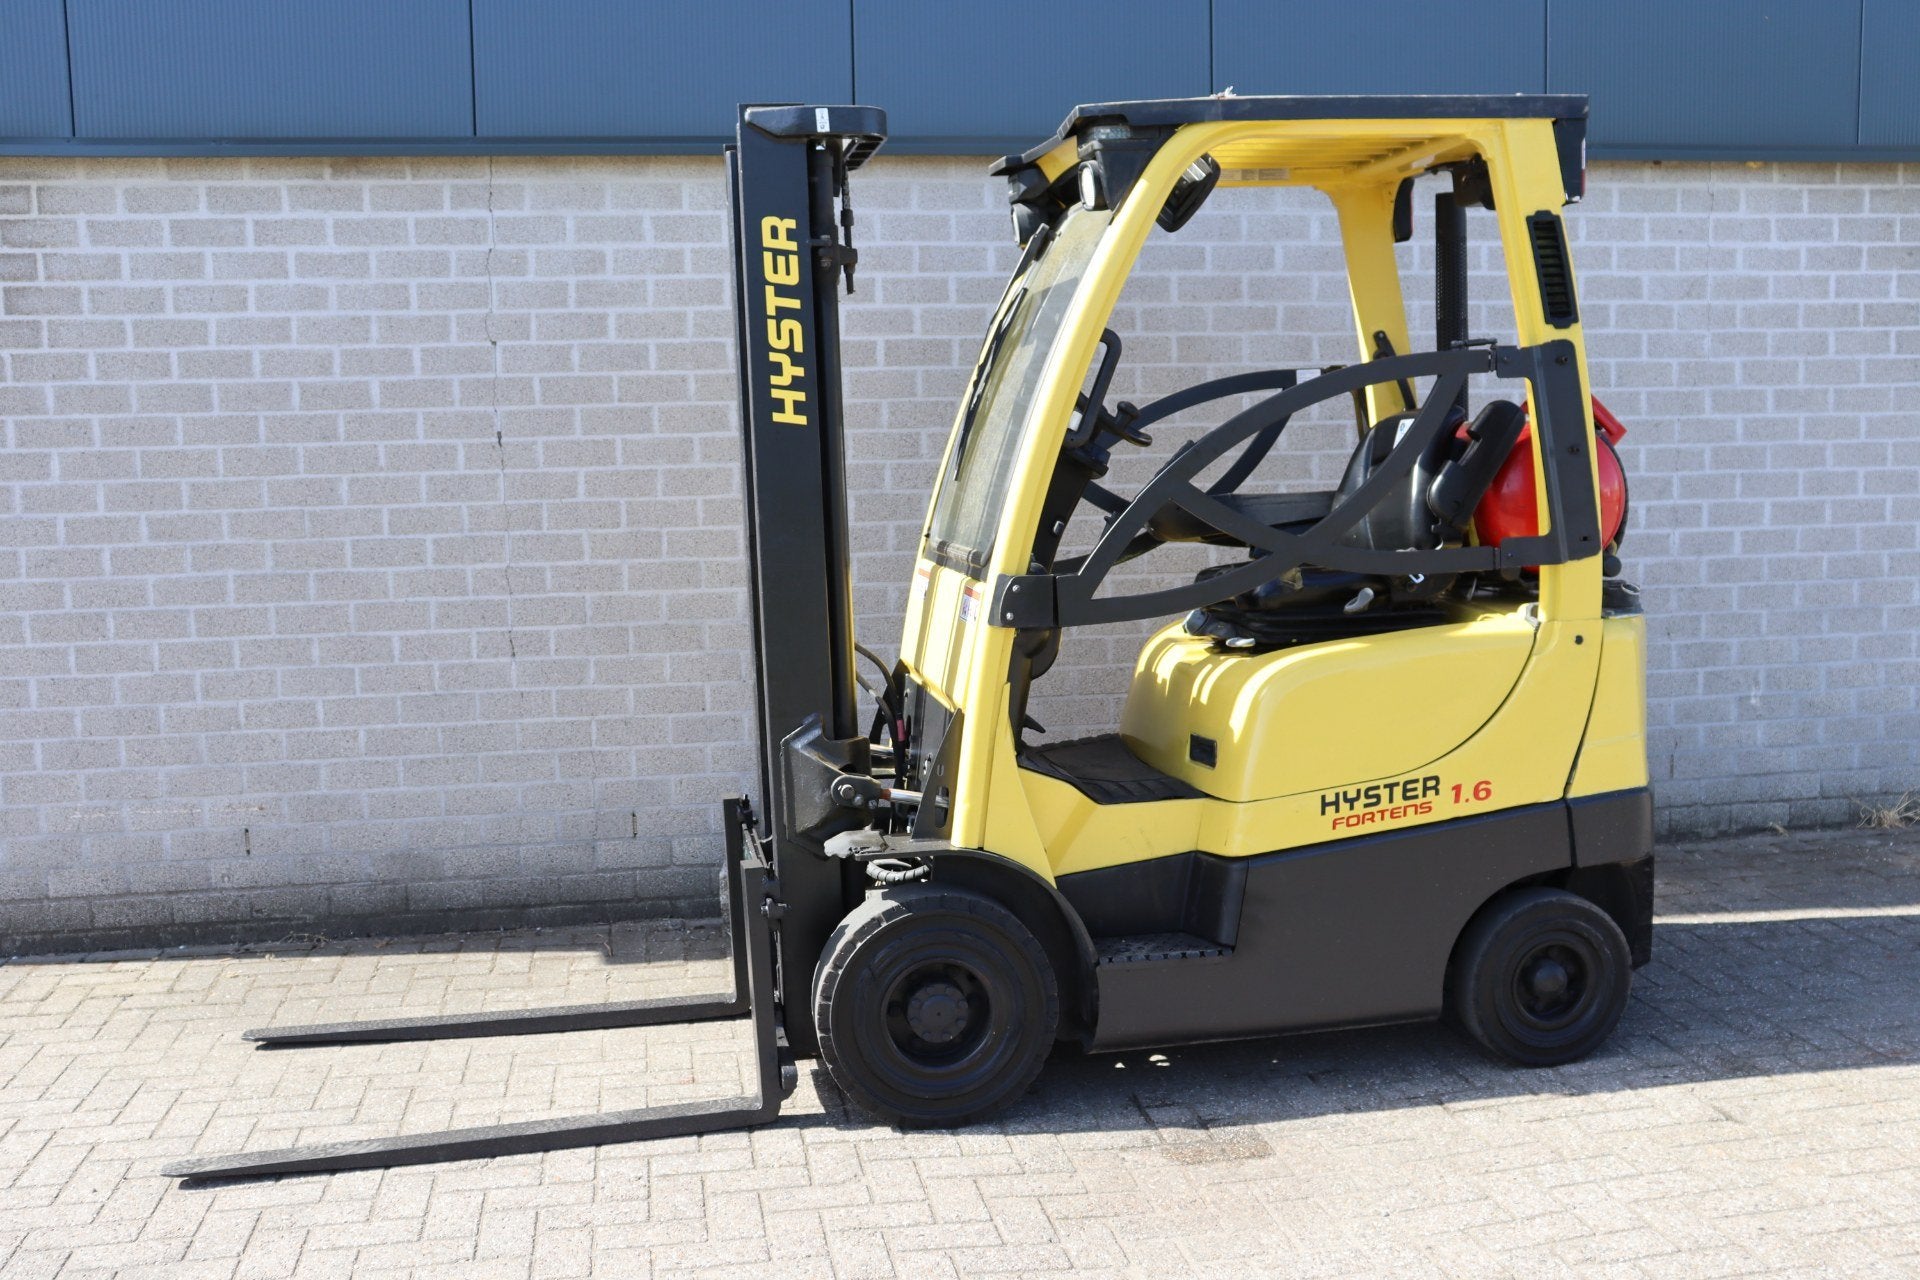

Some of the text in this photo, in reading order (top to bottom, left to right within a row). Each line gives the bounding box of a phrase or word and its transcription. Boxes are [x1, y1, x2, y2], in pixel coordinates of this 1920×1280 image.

[761, 215, 808, 426] HYSTER
[1320, 775, 1441, 816] HYSTER
[1451, 780, 1493, 804] 1.6
[1332, 801, 1433, 830] FORTENS
